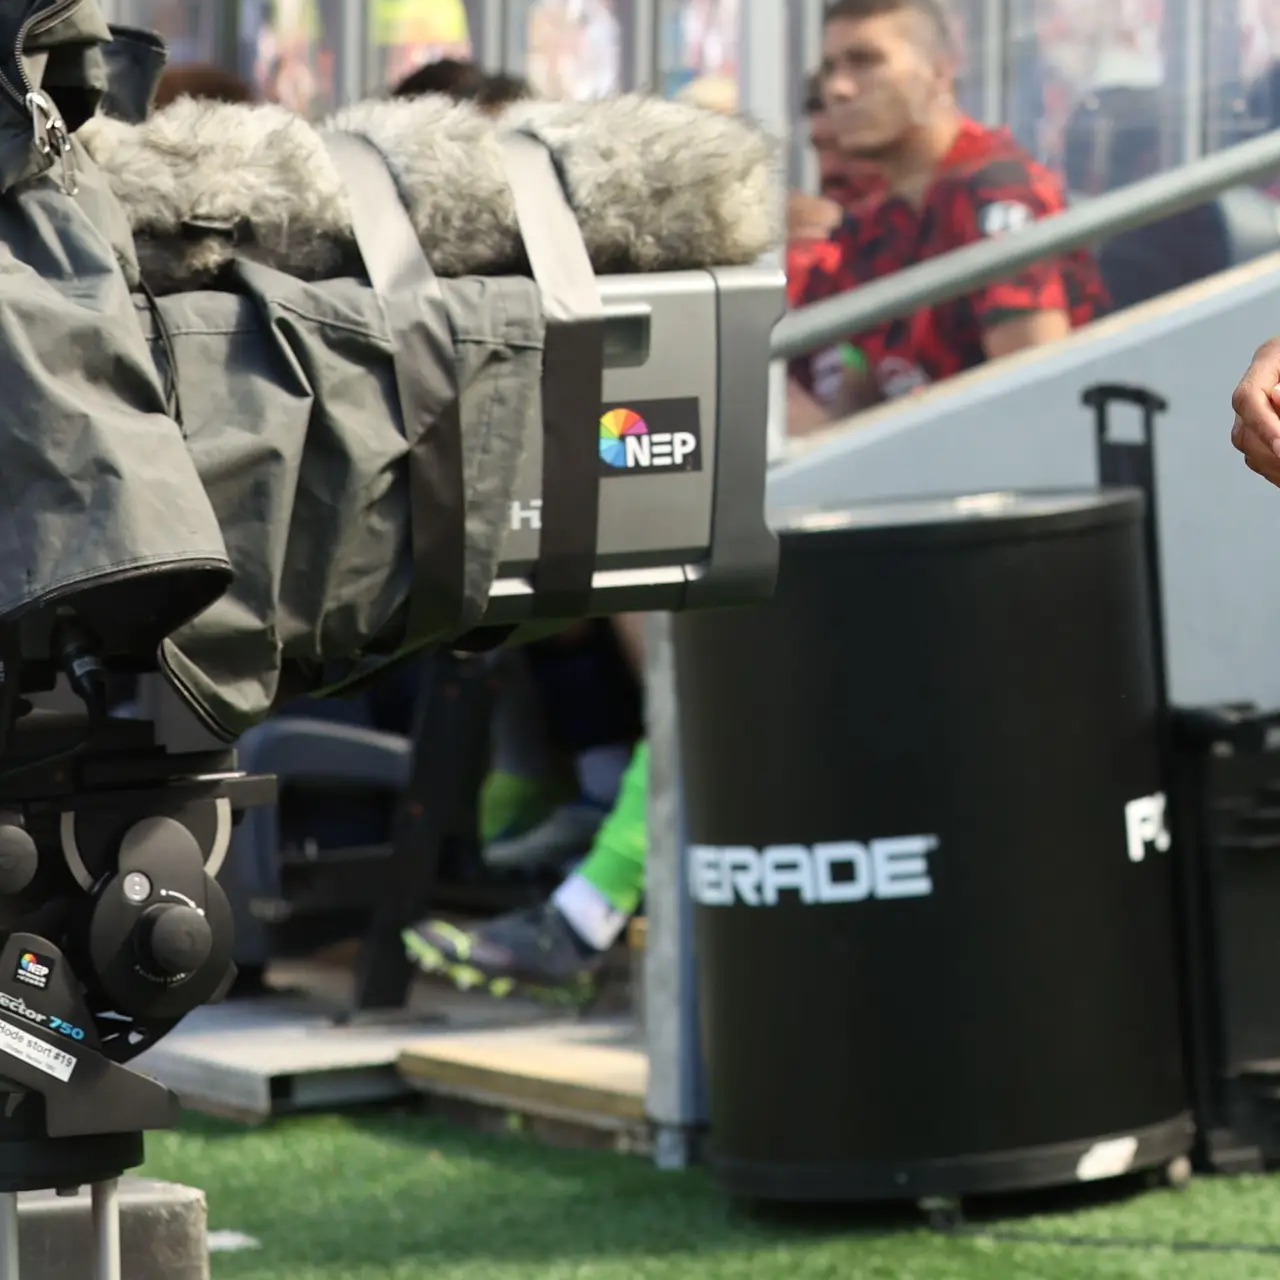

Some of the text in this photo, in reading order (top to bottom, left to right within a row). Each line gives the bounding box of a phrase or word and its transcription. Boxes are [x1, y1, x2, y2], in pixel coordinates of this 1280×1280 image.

[625, 431, 698, 468] NEP
[49, 1015, 85, 1041] 750
[53, 1051, 73, 1068] #19
